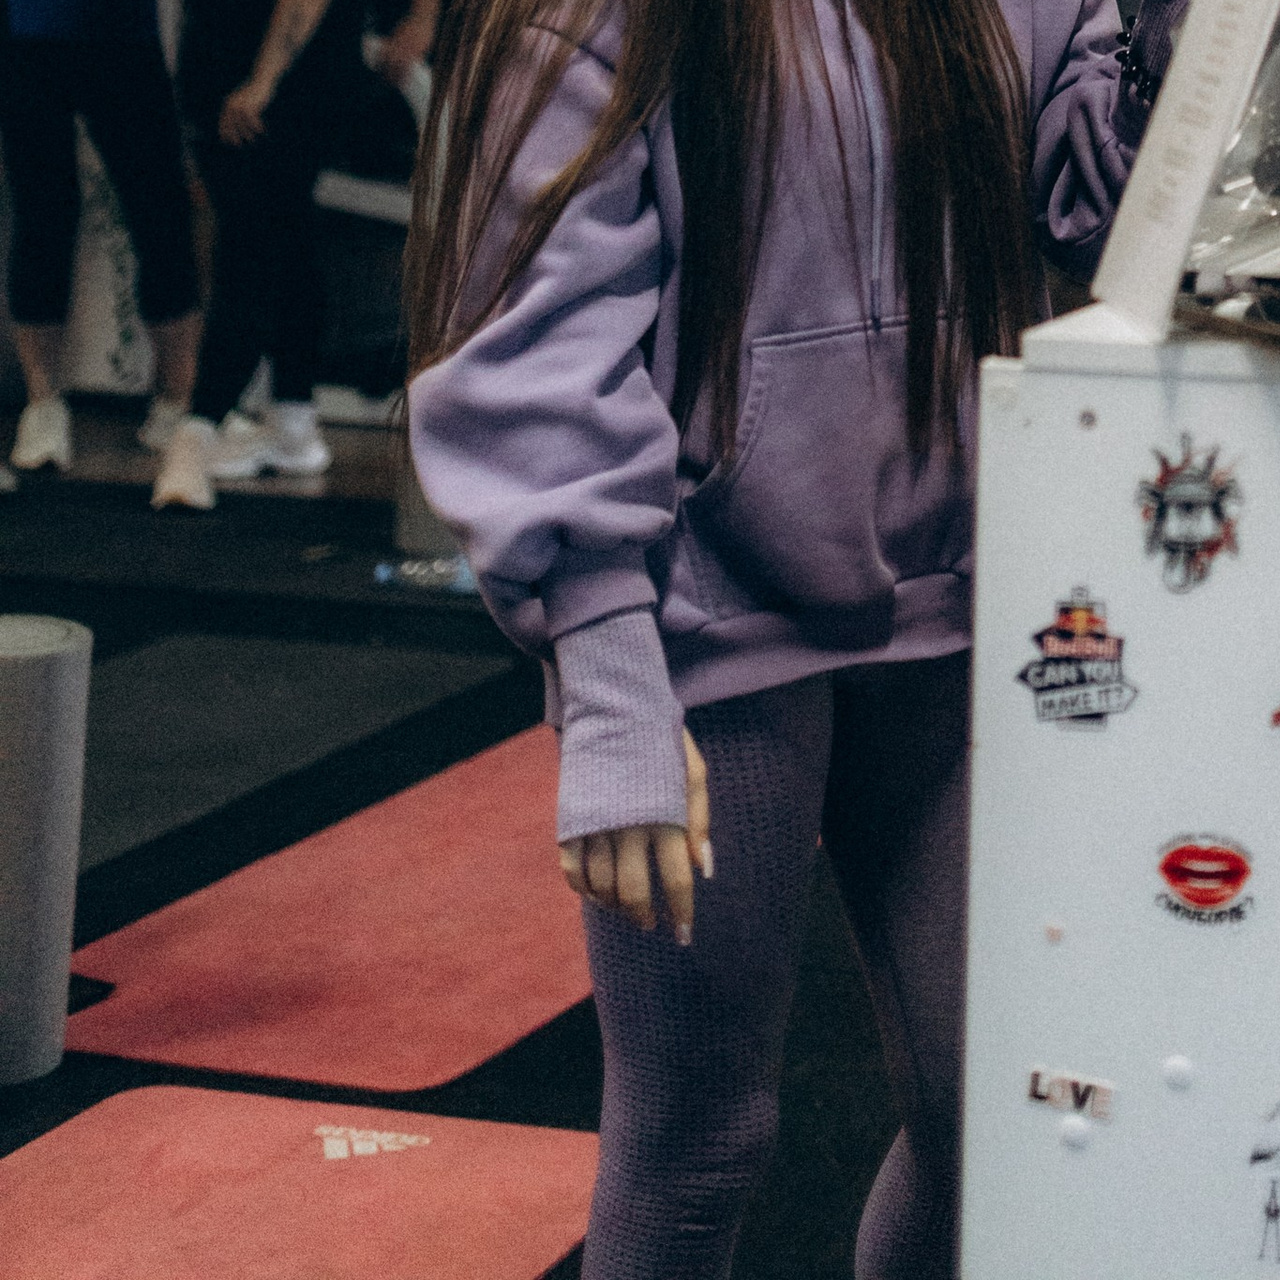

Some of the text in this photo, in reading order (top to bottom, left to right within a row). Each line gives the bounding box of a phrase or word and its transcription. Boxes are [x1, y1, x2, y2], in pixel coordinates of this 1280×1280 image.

[1027, 661, 1078, 689] CAN
[1041, 691, 1094, 718] MAKE
[1028, 1070, 1111, 1117] LOVE
